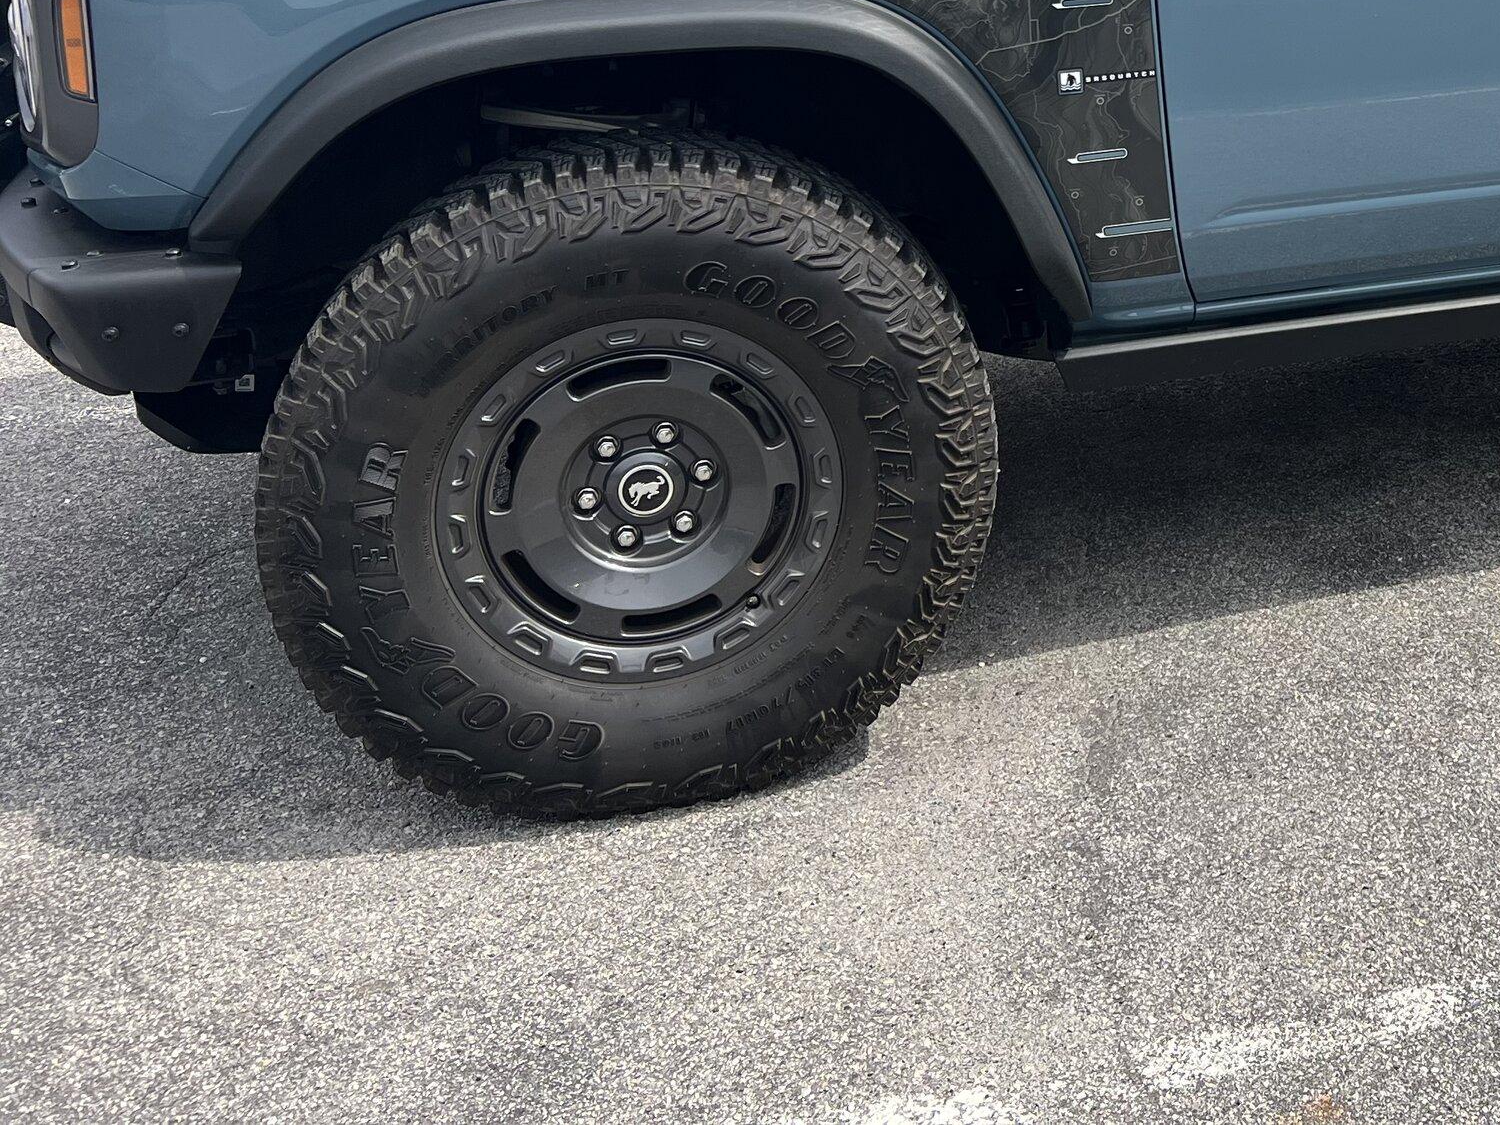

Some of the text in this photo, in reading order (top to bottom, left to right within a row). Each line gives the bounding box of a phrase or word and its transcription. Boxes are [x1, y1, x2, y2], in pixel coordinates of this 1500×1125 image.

[1085, 70, 1156, 83] SASQUATCH
[683, 260, 916, 574] GOODYEAR
[352, 441, 606, 761] GOODYEAR
